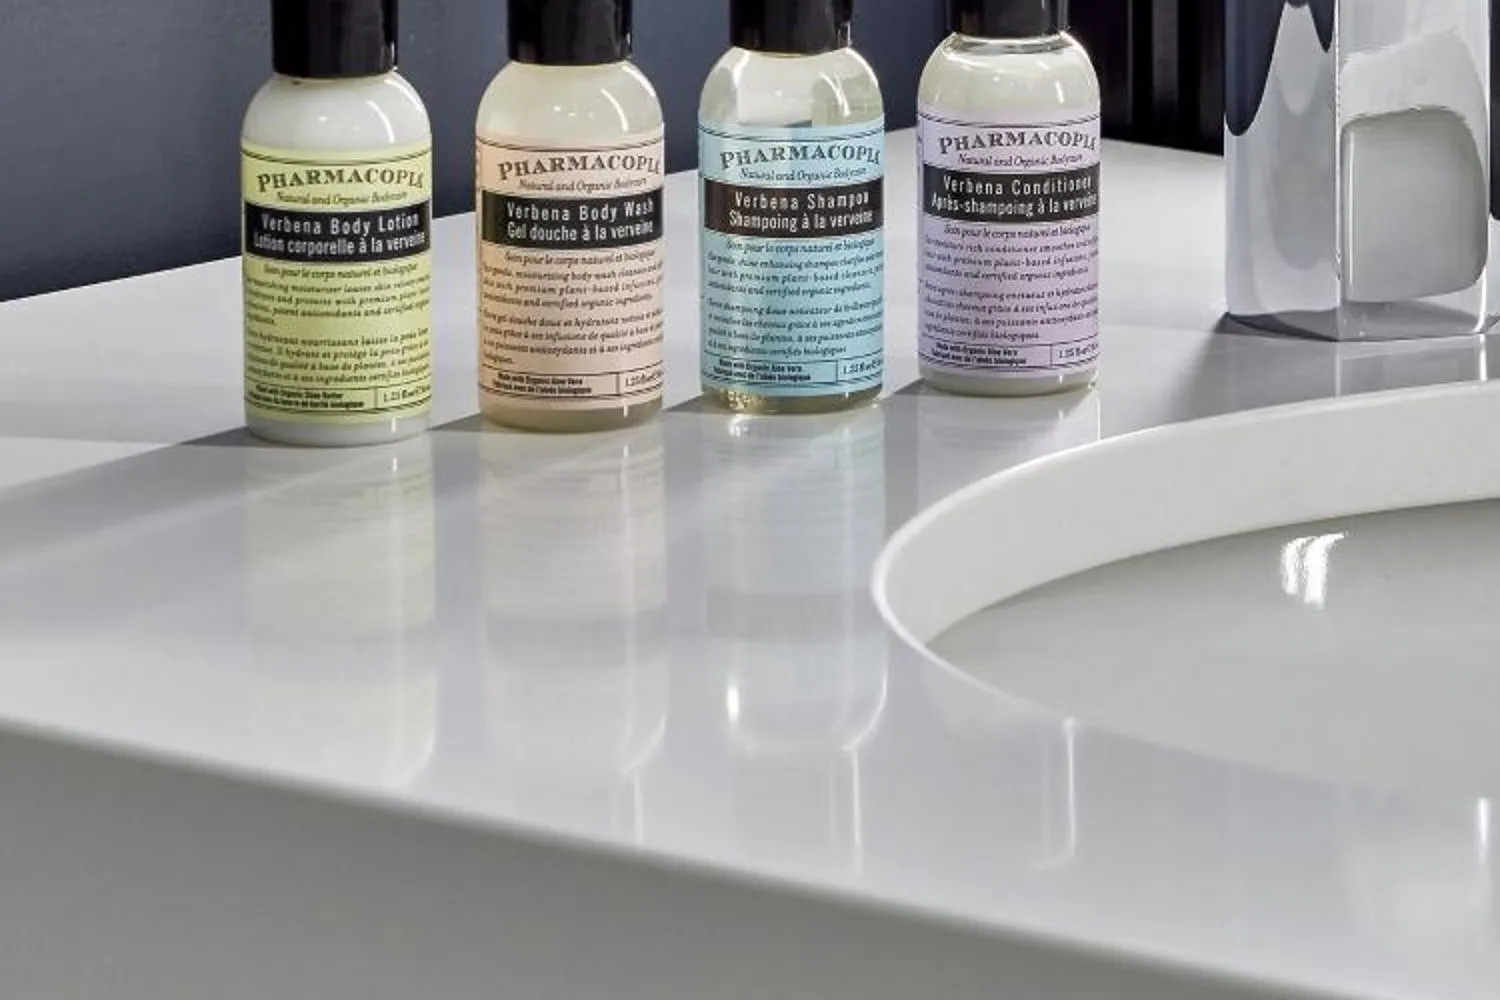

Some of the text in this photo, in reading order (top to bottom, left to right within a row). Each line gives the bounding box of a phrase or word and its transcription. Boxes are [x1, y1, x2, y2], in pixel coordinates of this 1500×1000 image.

[958, 153, 992, 165] Natural
[993, 155, 1012, 166] and
[1014, 155, 1049, 168] Organic
[776, 169, 795, 180] and
[798, 169, 833, 184] Organic
[555, 181, 574, 191] and
[576, 179, 612, 193] Organic
[943, 175, 1091, 195] Verbena Conditioner
[312, 193, 330, 204] and
[735, 192, 798, 210] Verbena
[1038, 198, 1045, 212] à
[1050, 197, 1060, 212] la
[507, 199, 654, 222] Verbena Body Wash
[261, 213, 419, 237] Verbena Body Lotion
[729, 209, 798, 232] Shampoing
[802, 211, 809, 229] à
[814, 211, 826, 228] la
[507, 221, 653, 241] Gel douche à la verveine
[961, 226, 982, 239] pour
[287, 239, 354, 256] corporelle
[359, 238, 367, 254] à
[371, 237, 383, 253] la
[523, 255, 544, 266] pour
